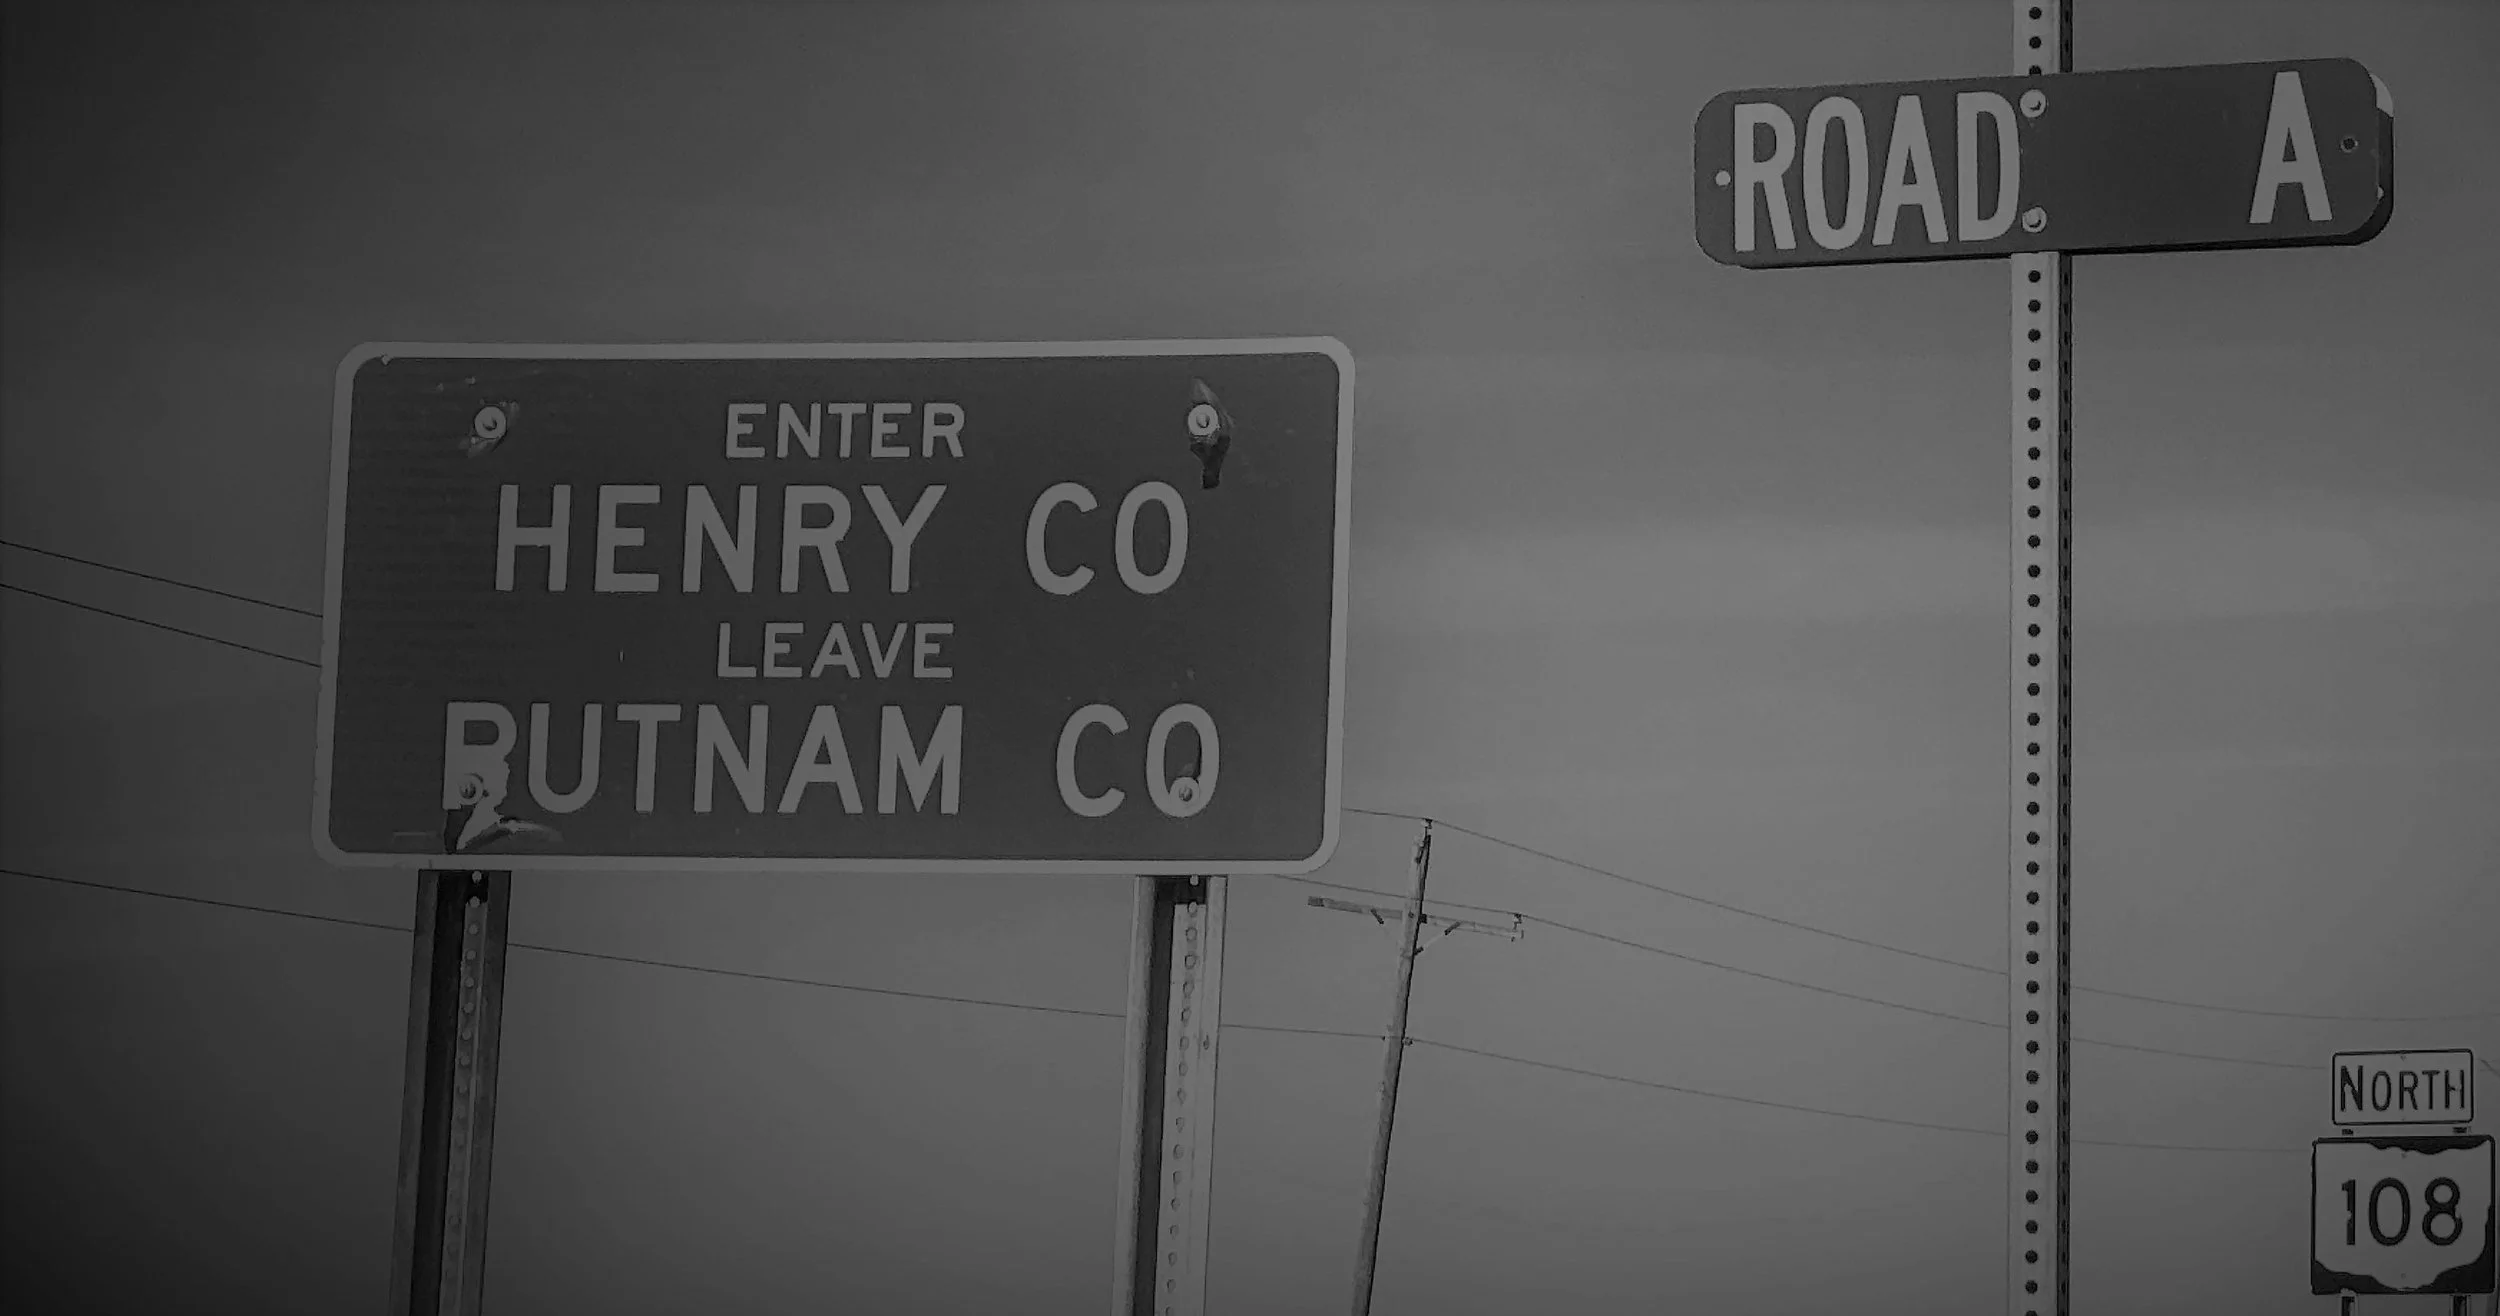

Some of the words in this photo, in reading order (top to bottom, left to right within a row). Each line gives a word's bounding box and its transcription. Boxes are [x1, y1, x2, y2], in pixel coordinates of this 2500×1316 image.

[1733, 91, 2021, 252] ROAD
[2249, 71, 2333, 224] A
[725, 402, 966, 458] ENTER
[495, 484, 948, 593] HENRY
[1026, 481, 1189, 596] CO
[717, 622, 955, 679] LEAVE
[442, 701, 964, 815] PUTNAM
[1056, 703, 1220, 818] CO
[2339, 1065, 2466, 1113] NORTH
[2341, 1177, 2463, 1246] 108
